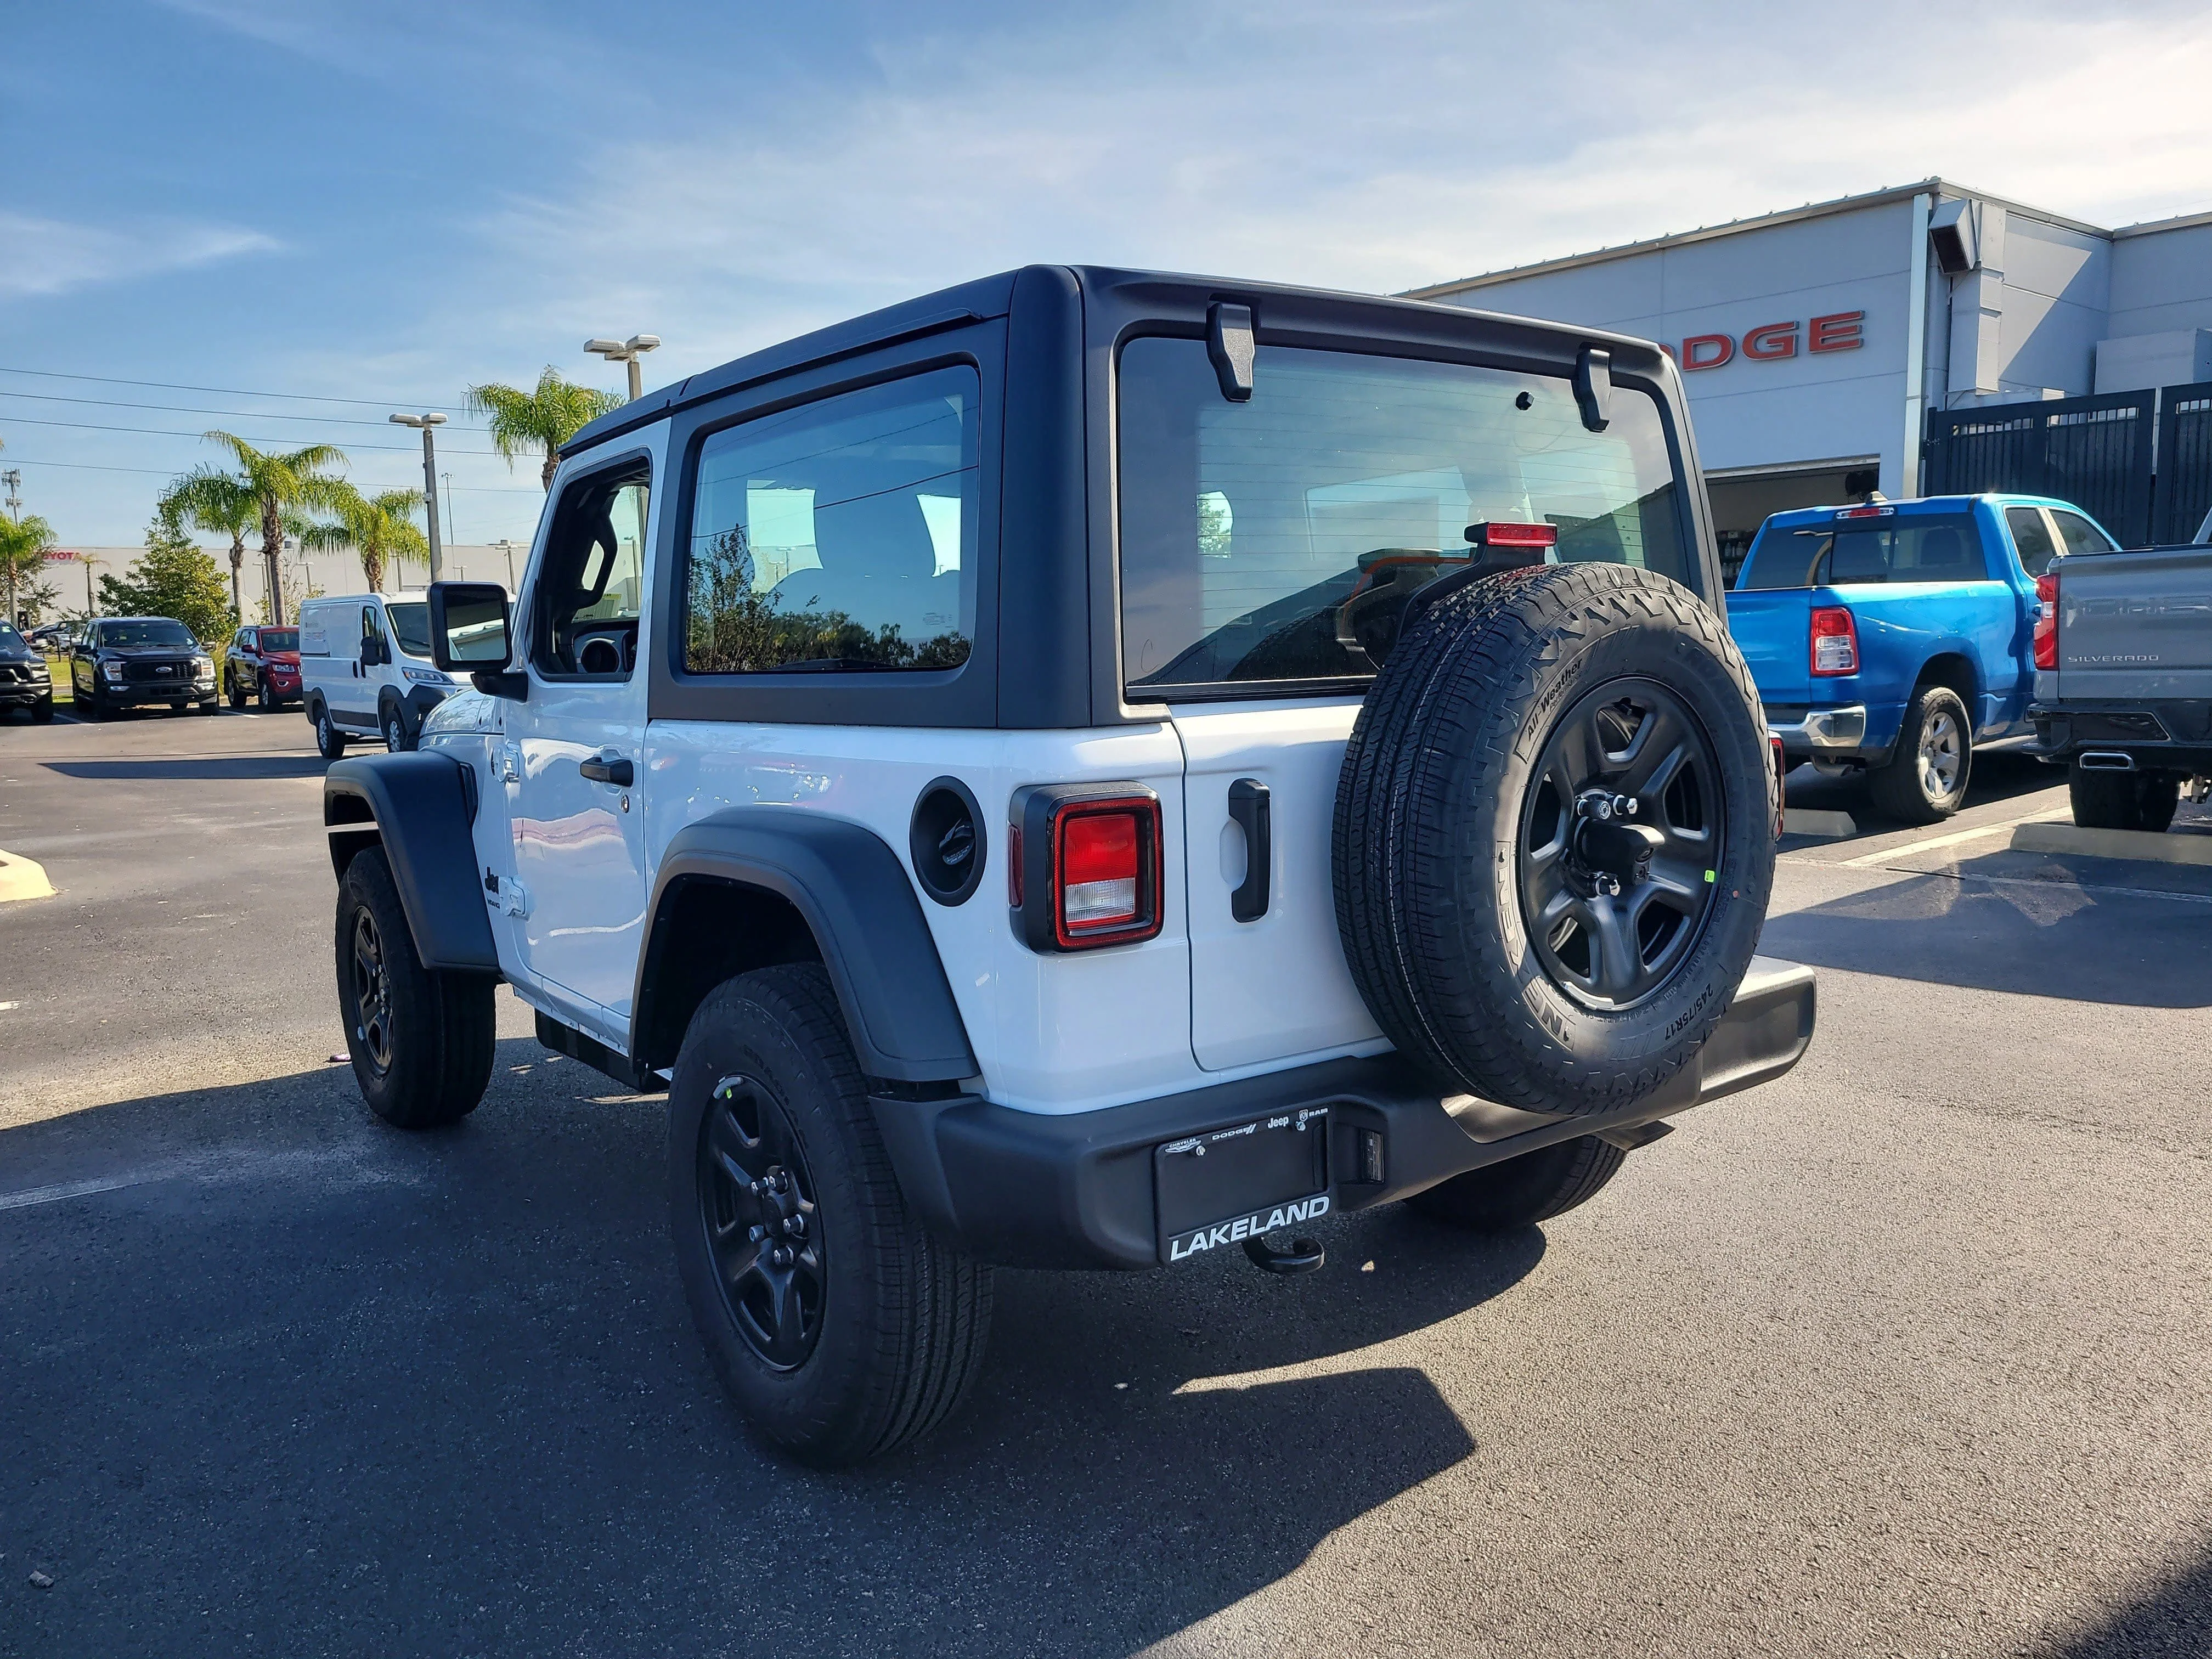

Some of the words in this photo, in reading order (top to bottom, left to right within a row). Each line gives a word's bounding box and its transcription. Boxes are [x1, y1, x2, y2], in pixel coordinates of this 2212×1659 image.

[1660, 309, 1866, 371] DGE
[2068, 654, 2160, 663] SILVERADO
[1527, 658, 1583, 742] All-Weather
[1665, 983, 1714, 1041] 245/75R17
[1169, 1138, 1197, 1148] CHRYSLER
[1212, 1126, 1251, 1141] DODGE
[1267, 1115, 1289, 1129] Jeep
[1308, 1108, 1328, 1117] RAM
[1170, 1196, 1330, 1262] LAKELAND
